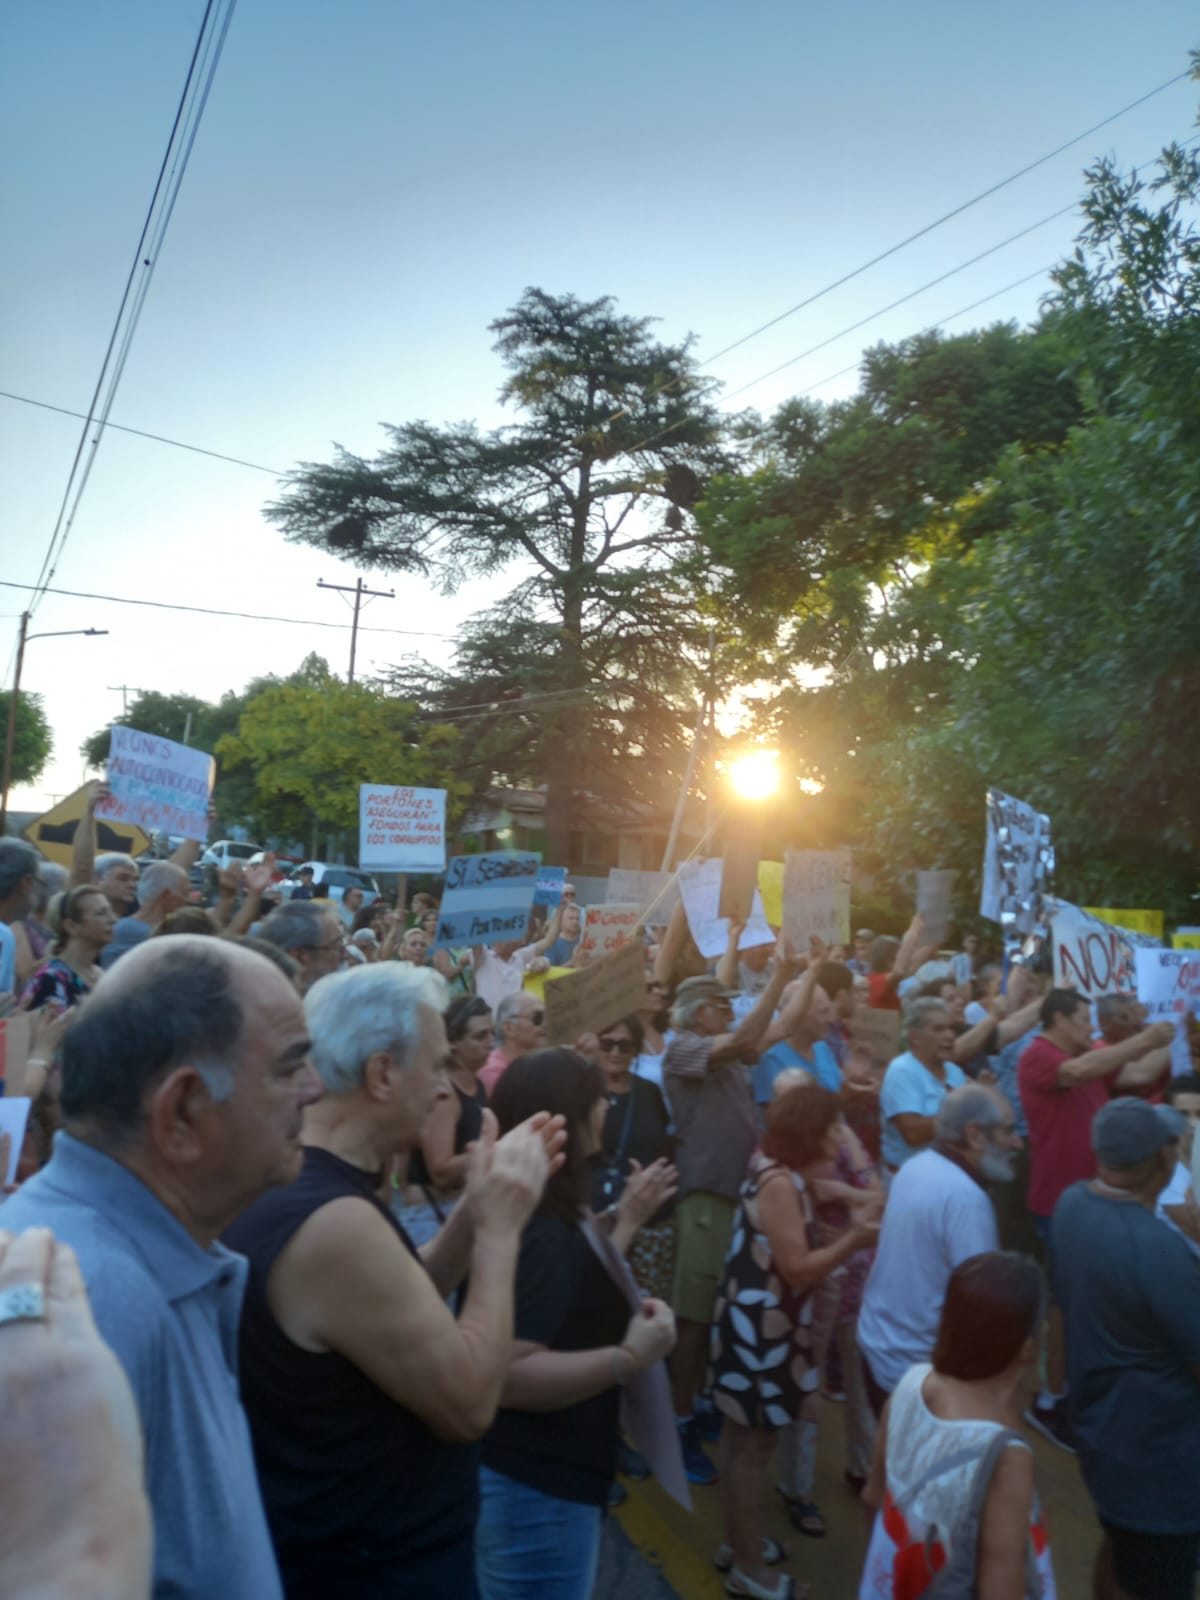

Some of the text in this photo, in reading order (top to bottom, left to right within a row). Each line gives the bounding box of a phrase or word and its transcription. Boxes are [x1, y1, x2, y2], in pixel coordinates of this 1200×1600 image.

[367, 794, 433, 809] PORTONES
[367, 833, 385, 845] LOS
[470, 914, 525, 937] PORTONES
